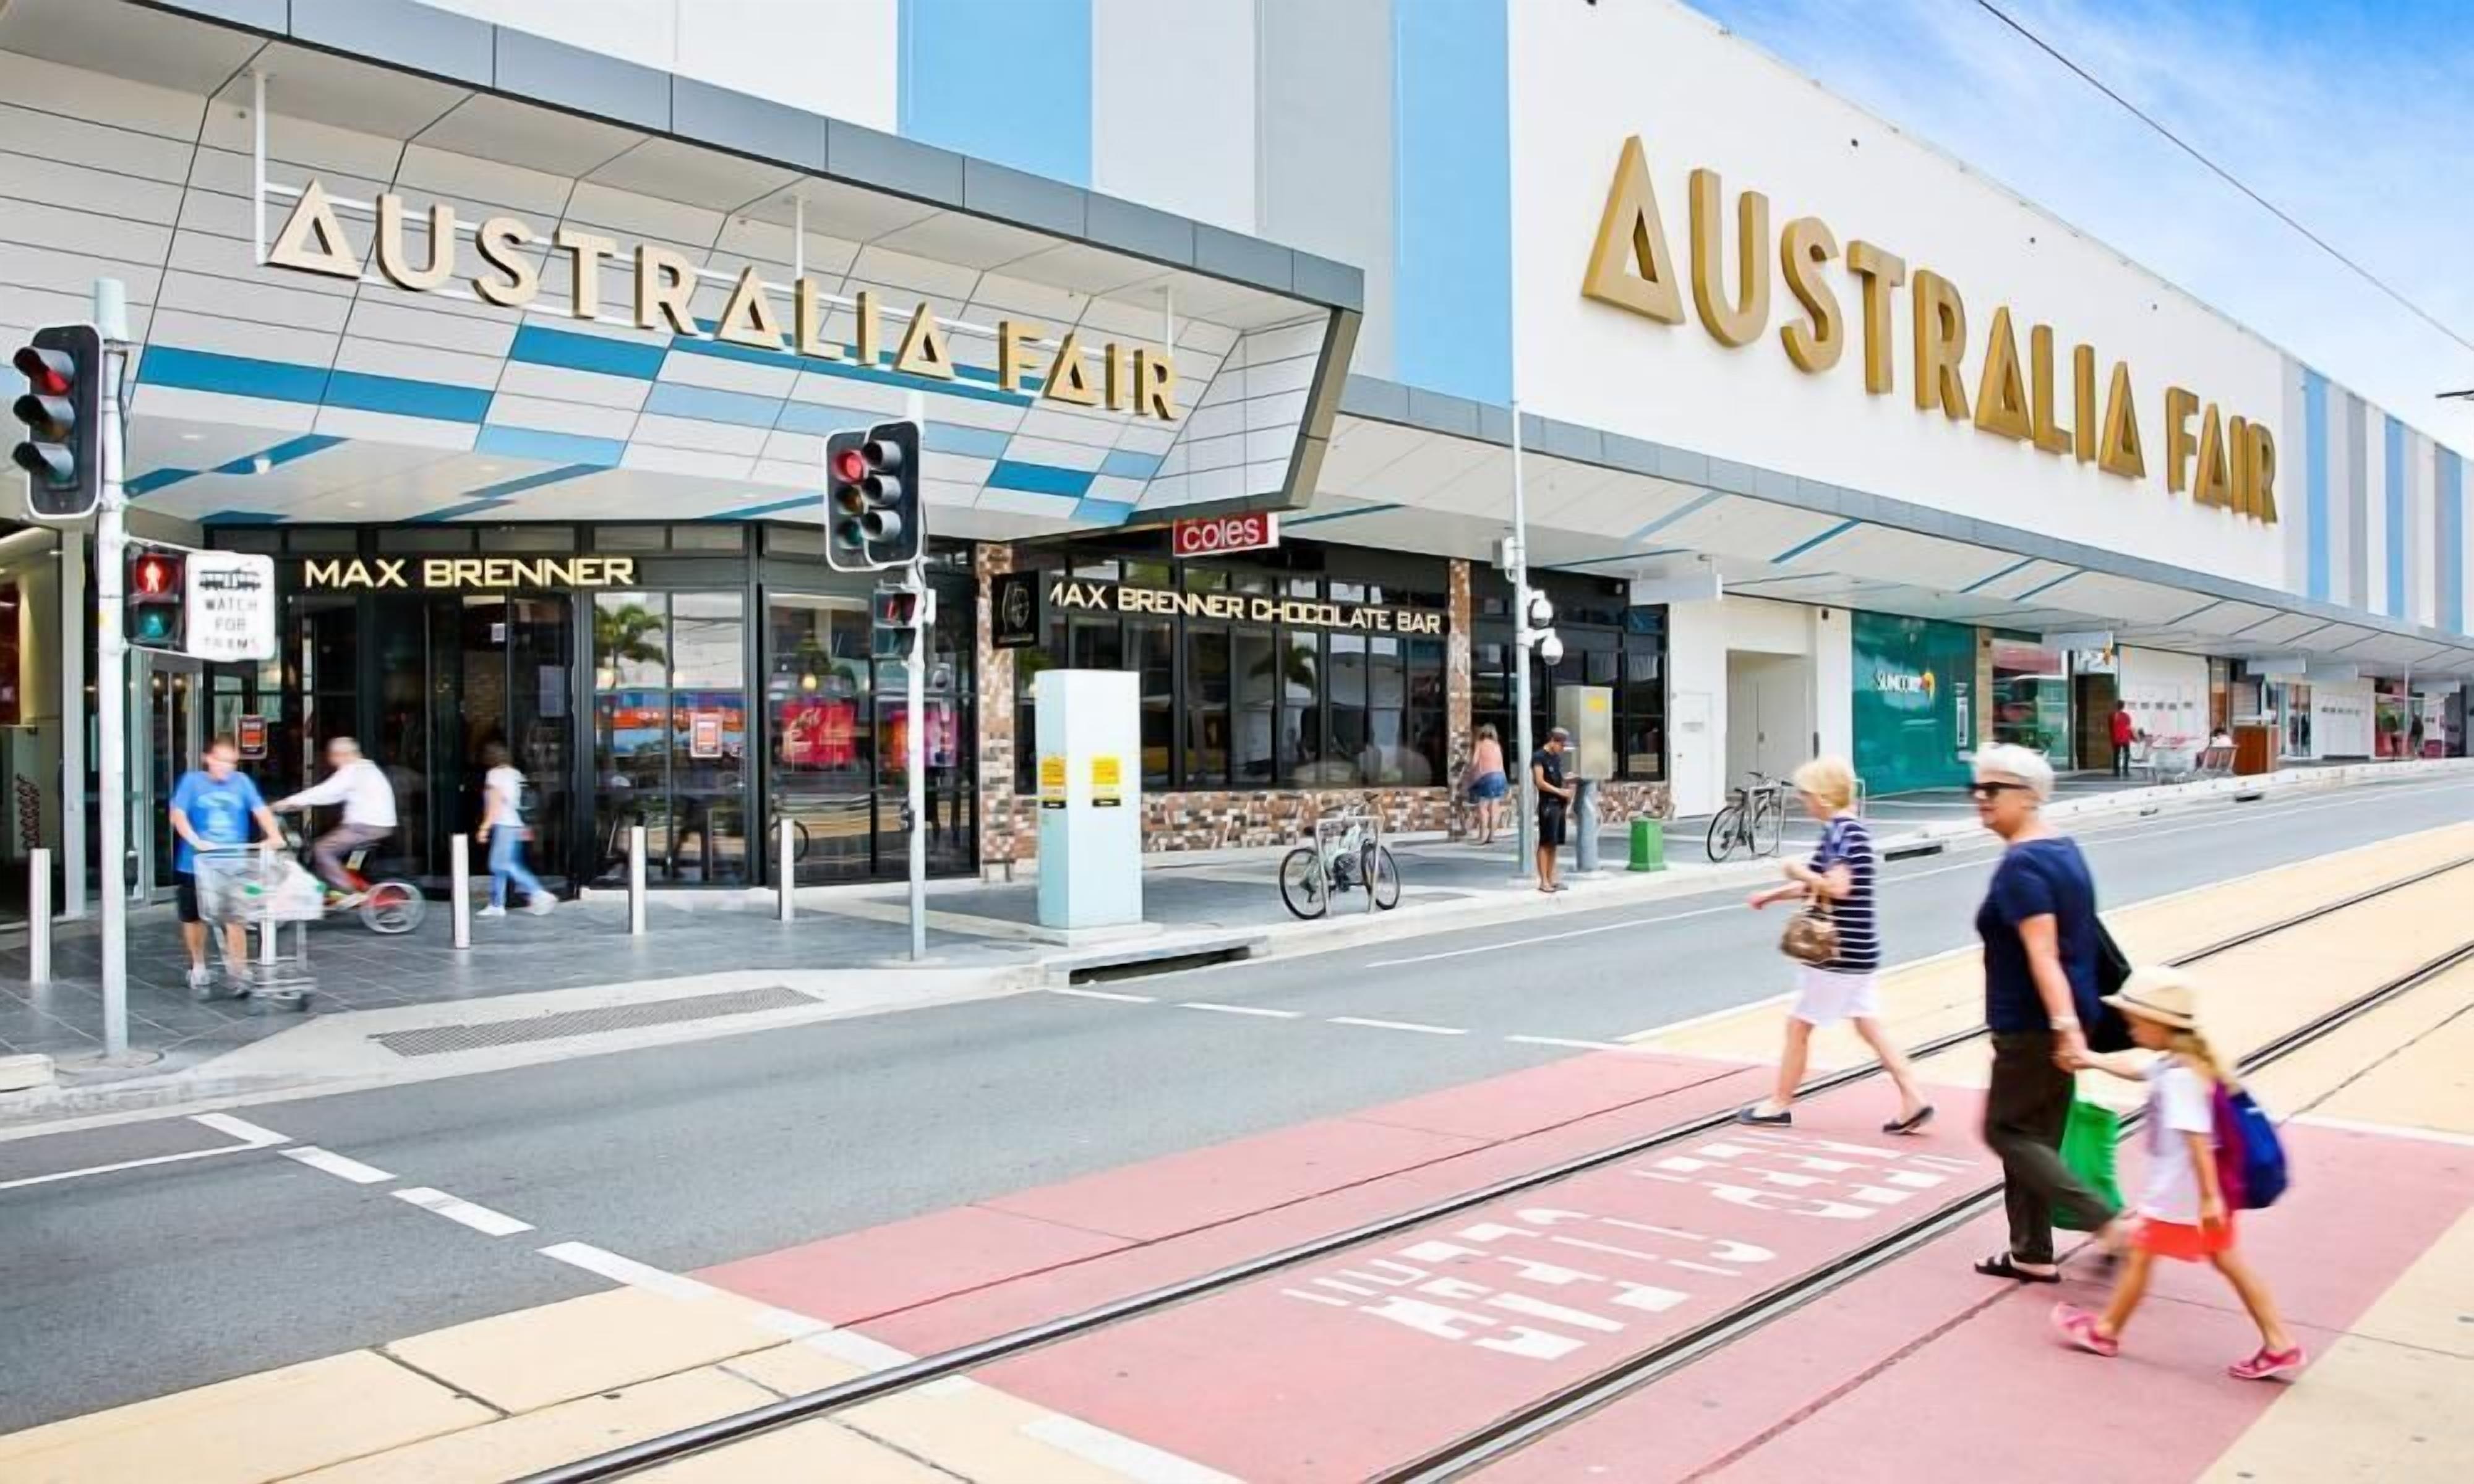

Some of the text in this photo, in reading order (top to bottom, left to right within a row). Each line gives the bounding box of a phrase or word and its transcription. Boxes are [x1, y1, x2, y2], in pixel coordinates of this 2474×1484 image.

[265, 177, 1179, 420] AUSTRALIA FAIR
[1581, 135, 2279, 524] AUSTRALIA FAIR
[1183, 518, 1260, 550] coles
[304, 557, 634, 588] MAX BRENNER
[1118, 587, 1244, 620] BRENNER
[1252, 597, 1390, 631] CHOCOLATE
[1397, 610, 1441, 634] BAR
